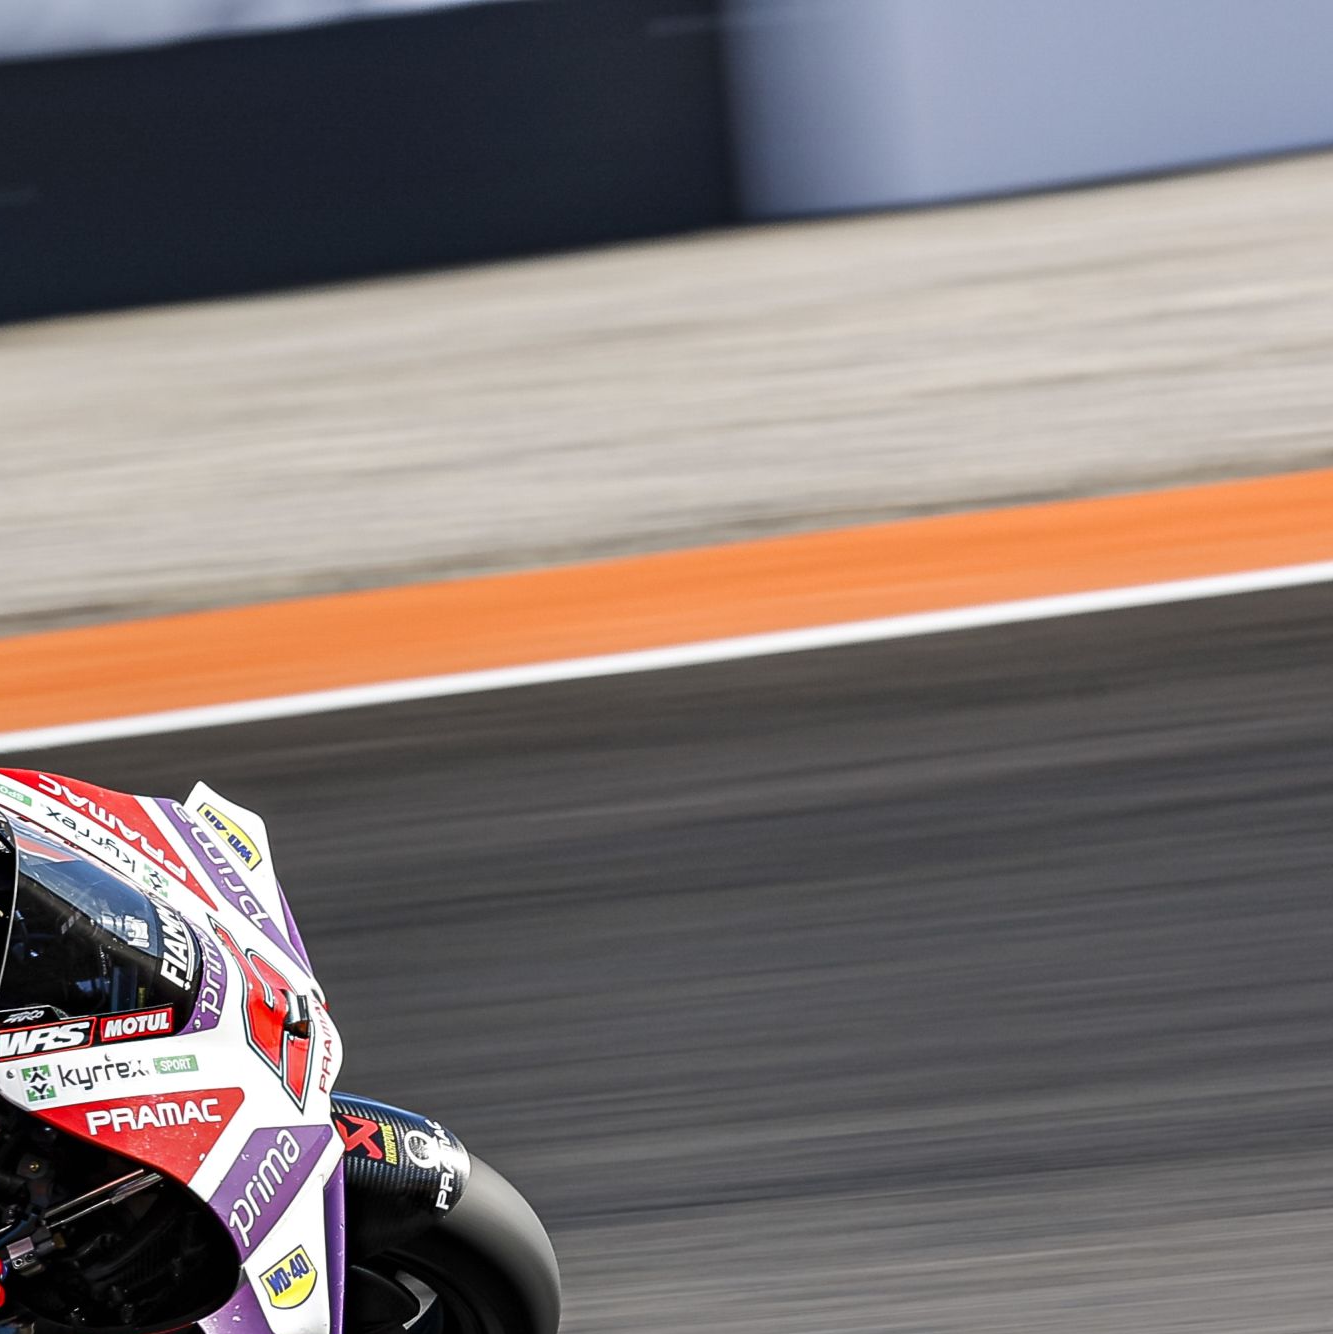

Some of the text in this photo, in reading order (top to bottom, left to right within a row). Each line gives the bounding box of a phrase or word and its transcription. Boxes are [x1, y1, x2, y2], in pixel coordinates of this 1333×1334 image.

[37, 773, 188, 882] PRAMAC
[44, 804, 136, 873] kyrrex
[203, 807, 253, 866] WD-40
[170, 801, 271, 930] prima
[103, 1011, 171, 1040] MOTUL
[57, 1056, 193, 1092] kyrrex SPORT
[85, 1097, 223, 1136] PRAMAC
[227, 1127, 303, 1248] prima
[263, 1250, 311, 1297] WD-40
